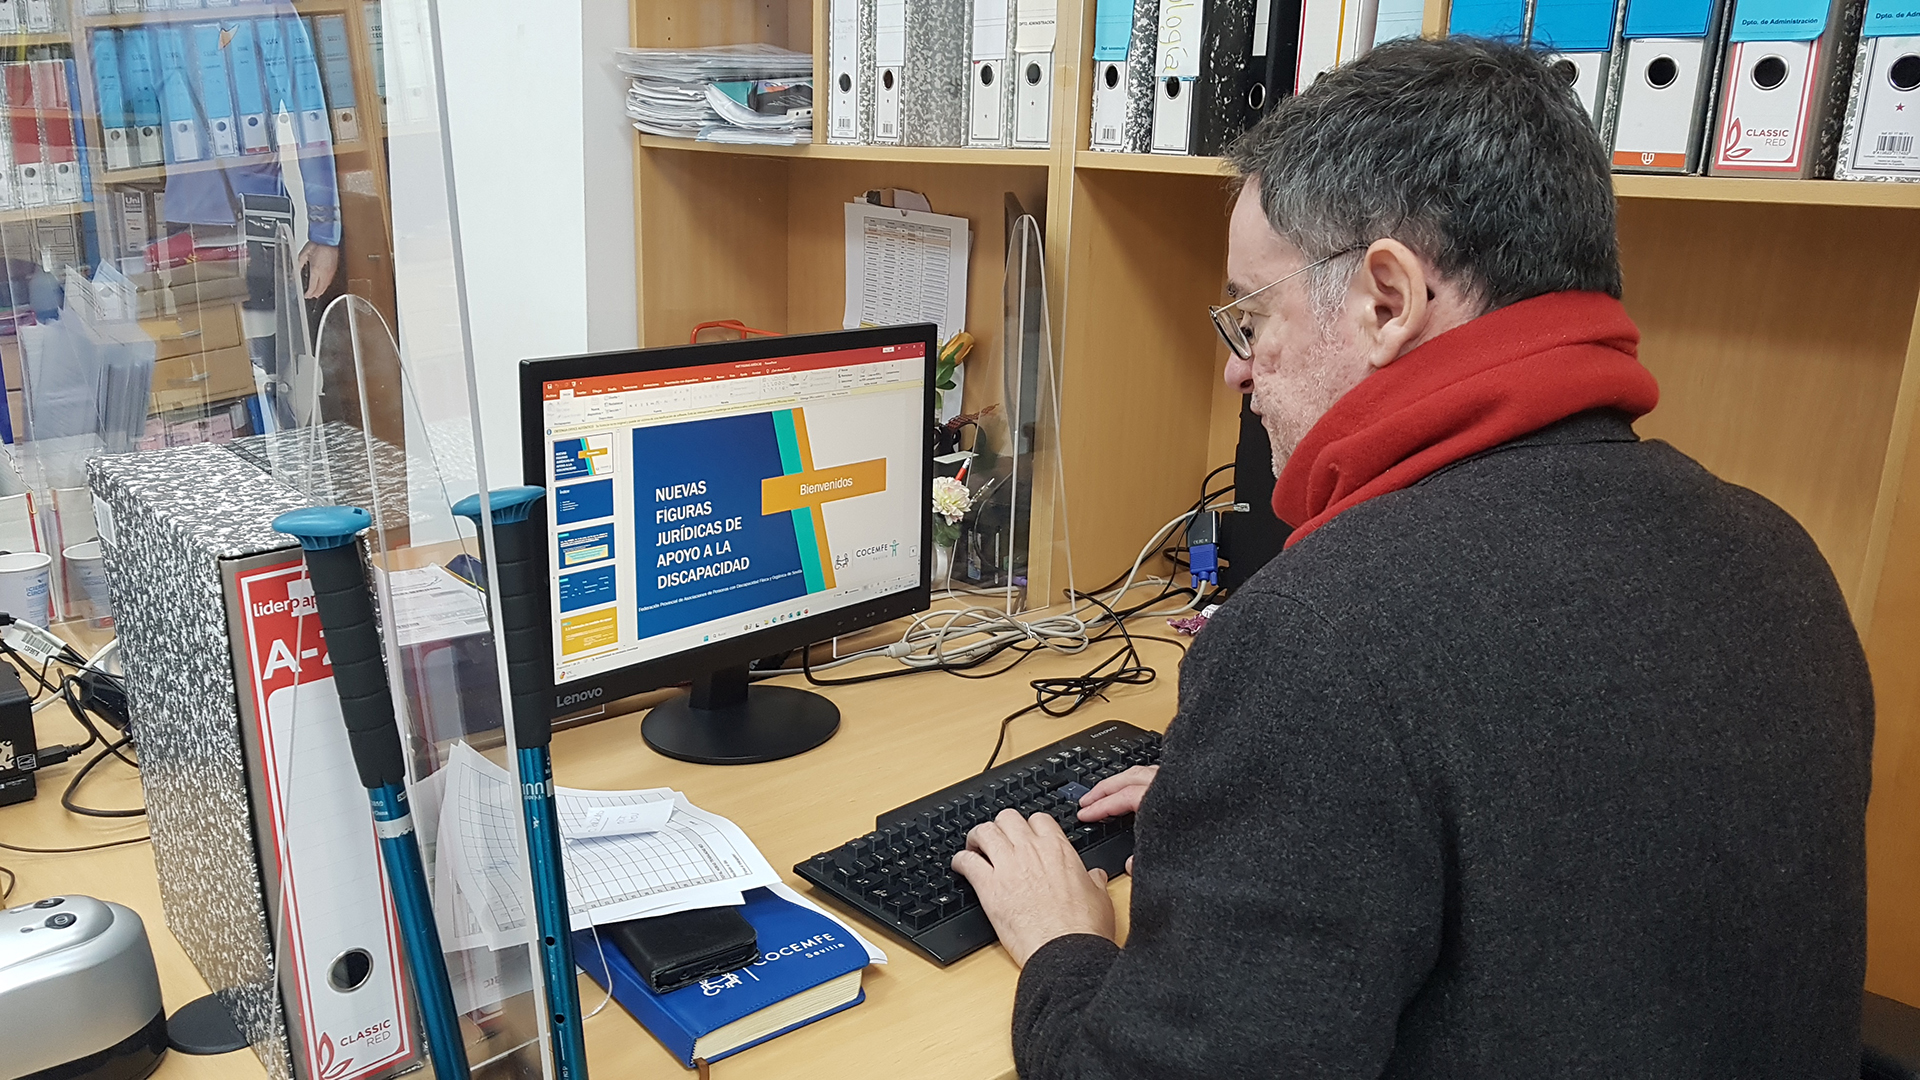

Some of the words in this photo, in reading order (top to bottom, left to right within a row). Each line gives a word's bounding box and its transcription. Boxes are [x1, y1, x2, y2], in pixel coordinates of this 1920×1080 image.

[1158, 0, 1195, 73] logía
[1746, 128, 1789, 137] CLASSIC
[1764, 138, 1786, 147] RED
[125, 196, 140, 204] Uni
[655, 480, 707, 502] NUEVAS
[800, 477, 854, 496] Bienvenidos
[656, 500, 712, 524] FIGURAS
[656, 520, 722, 546] JURÍDICAS
[726, 516, 742, 532] DE
[656, 546, 700, 568] APOYO
[703, 544, 713, 558] A
[716, 540, 732, 555] LA
[856, 544, 888, 558] COCEMFE
[657, 556, 750, 590] DISCAPACIDAD
[556, 687, 603, 708] Lenovo
[1090, 726, 1118, 738] lenovo
[804, 943, 846, 959] Sevilla
[340, 1020, 391, 1047] CLASSIC
[366, 1030, 391, 1048] RED
